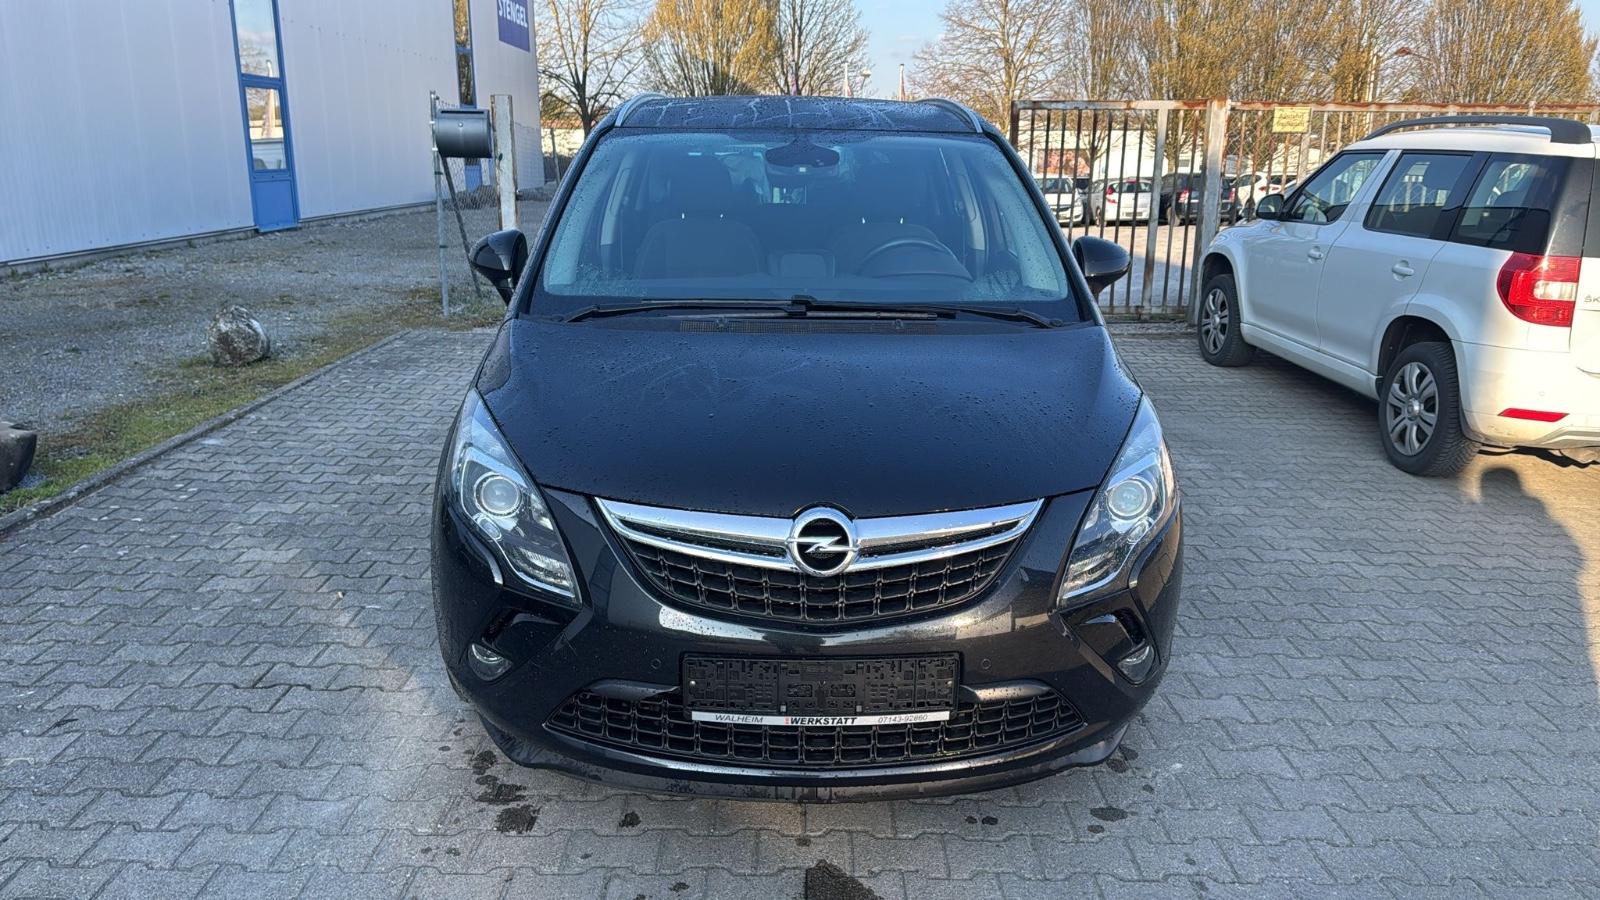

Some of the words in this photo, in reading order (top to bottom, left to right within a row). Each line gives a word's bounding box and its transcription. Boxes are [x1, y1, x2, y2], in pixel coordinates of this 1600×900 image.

[498, 0, 528, 28] STENGEL
[715, 714, 764, 724] WALHEIM
[791, 717, 857, 725] WERKSTATT
